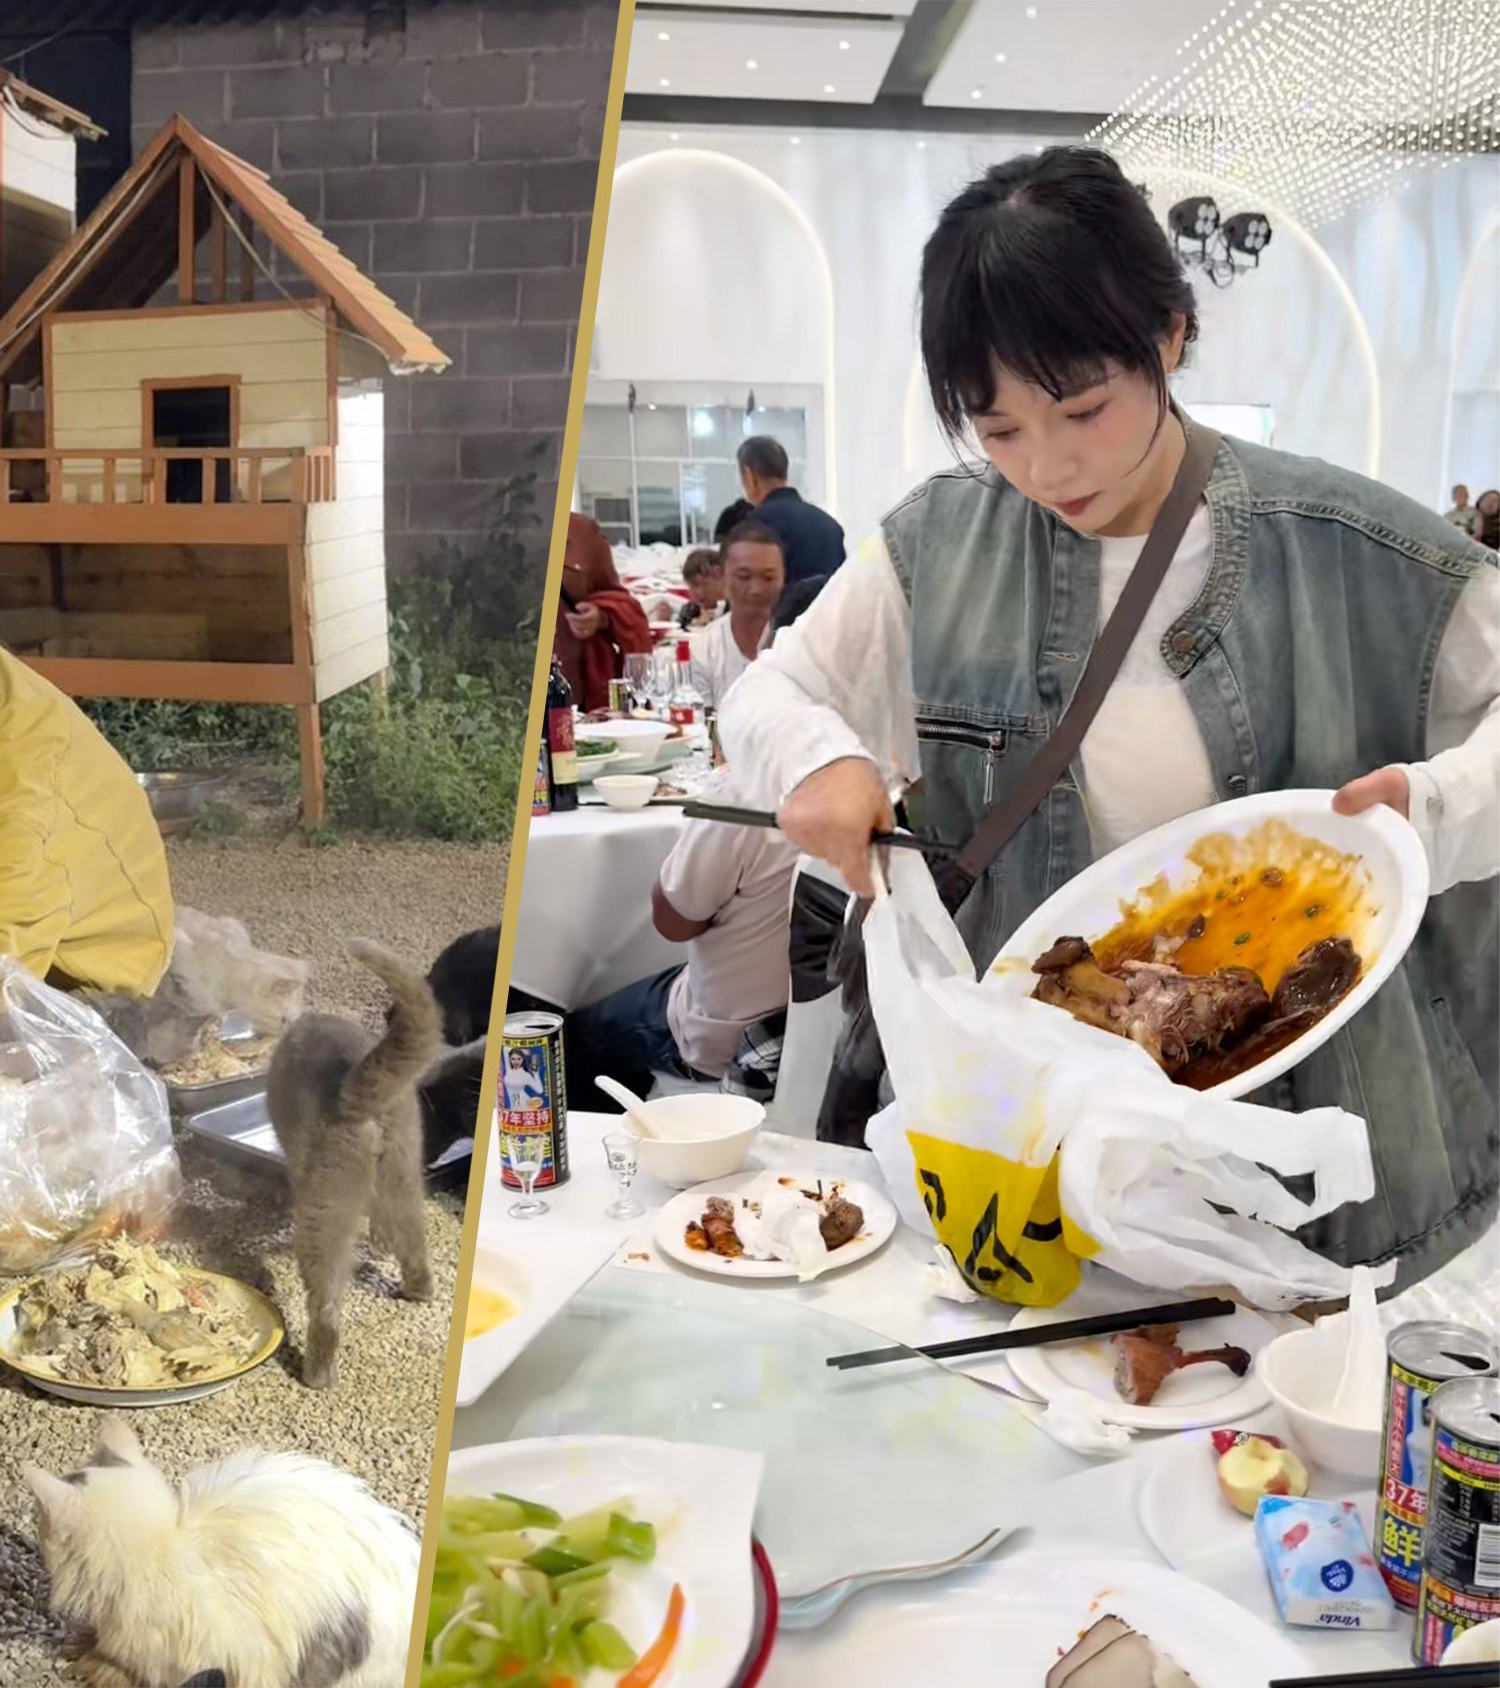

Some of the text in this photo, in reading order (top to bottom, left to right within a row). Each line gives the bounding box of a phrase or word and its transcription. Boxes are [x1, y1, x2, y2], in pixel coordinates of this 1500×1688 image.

[1386, 1478, 1427, 1513] 37年
[1383, 1516, 1422, 1567] 鲜
[1319, 1613, 1361, 1627] Vinda
